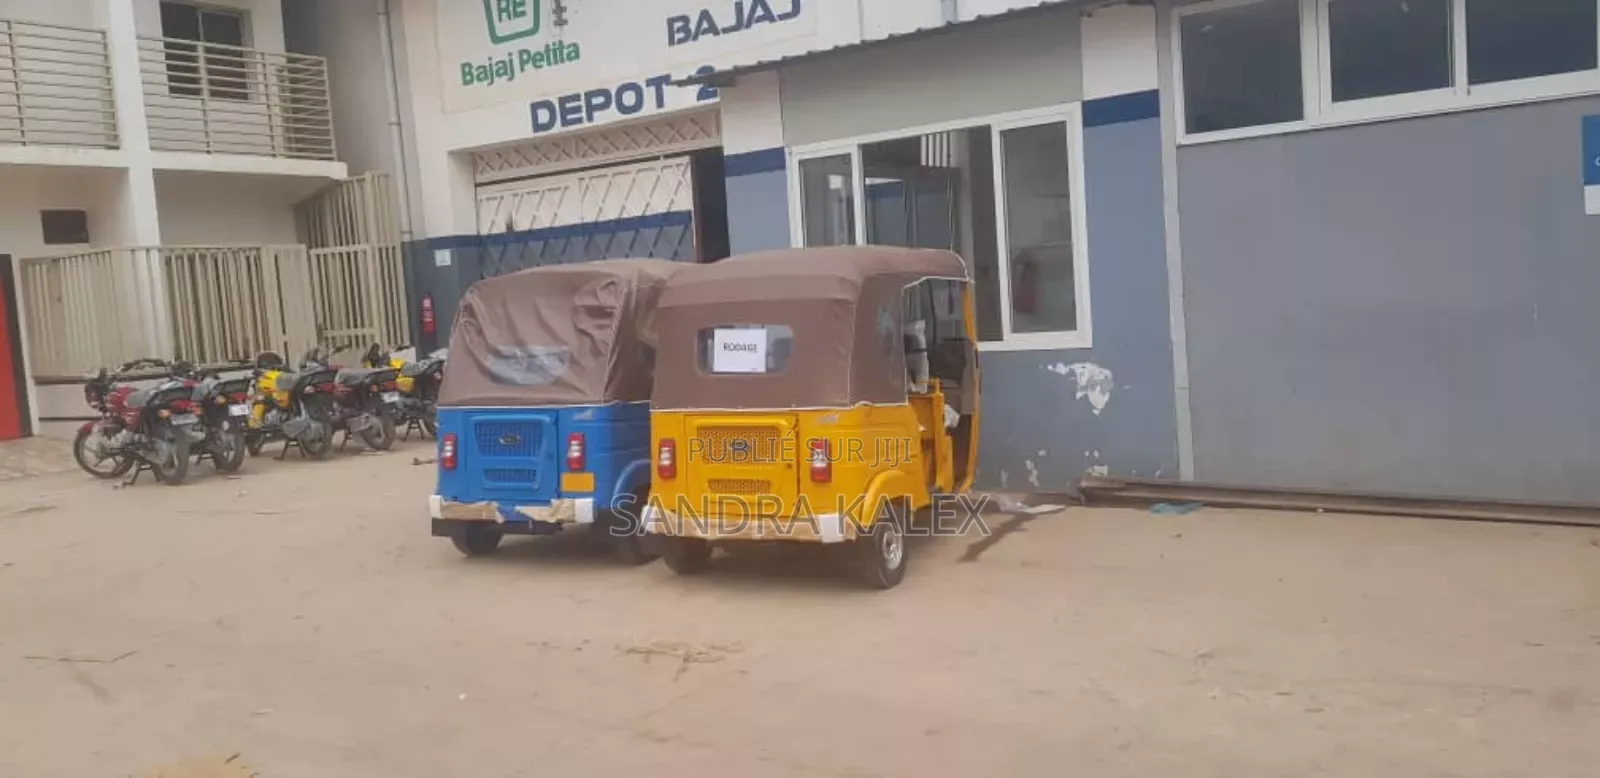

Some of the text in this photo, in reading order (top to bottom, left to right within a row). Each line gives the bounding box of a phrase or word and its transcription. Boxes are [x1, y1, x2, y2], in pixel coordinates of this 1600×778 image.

[666, 0, 801, 47] BAJAJ
[461, 40, 581, 86] Bajaj Petita
[530, 73, 671, 133] DEPOT
